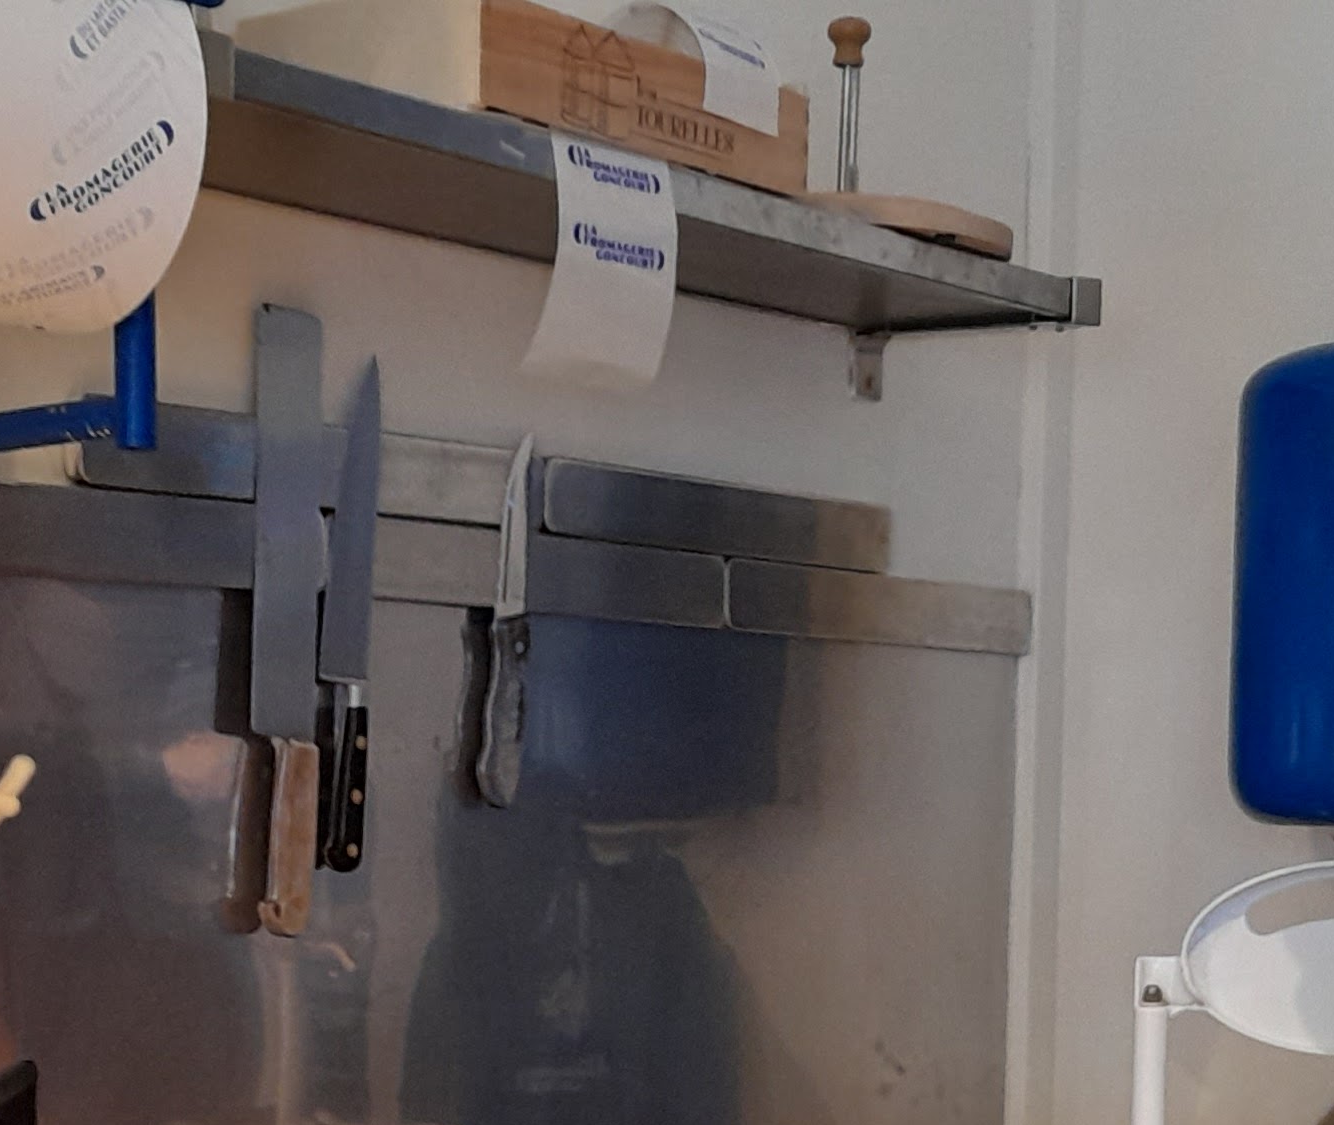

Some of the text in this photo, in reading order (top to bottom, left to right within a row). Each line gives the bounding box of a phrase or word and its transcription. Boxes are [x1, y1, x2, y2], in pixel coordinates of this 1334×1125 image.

[635, 105, 734, 153] TOURELLES
[45, 183, 68, 203] LA
[49, 128, 158, 215] FROMAGERIE
[74, 141, 163, 213] GONCOURT
